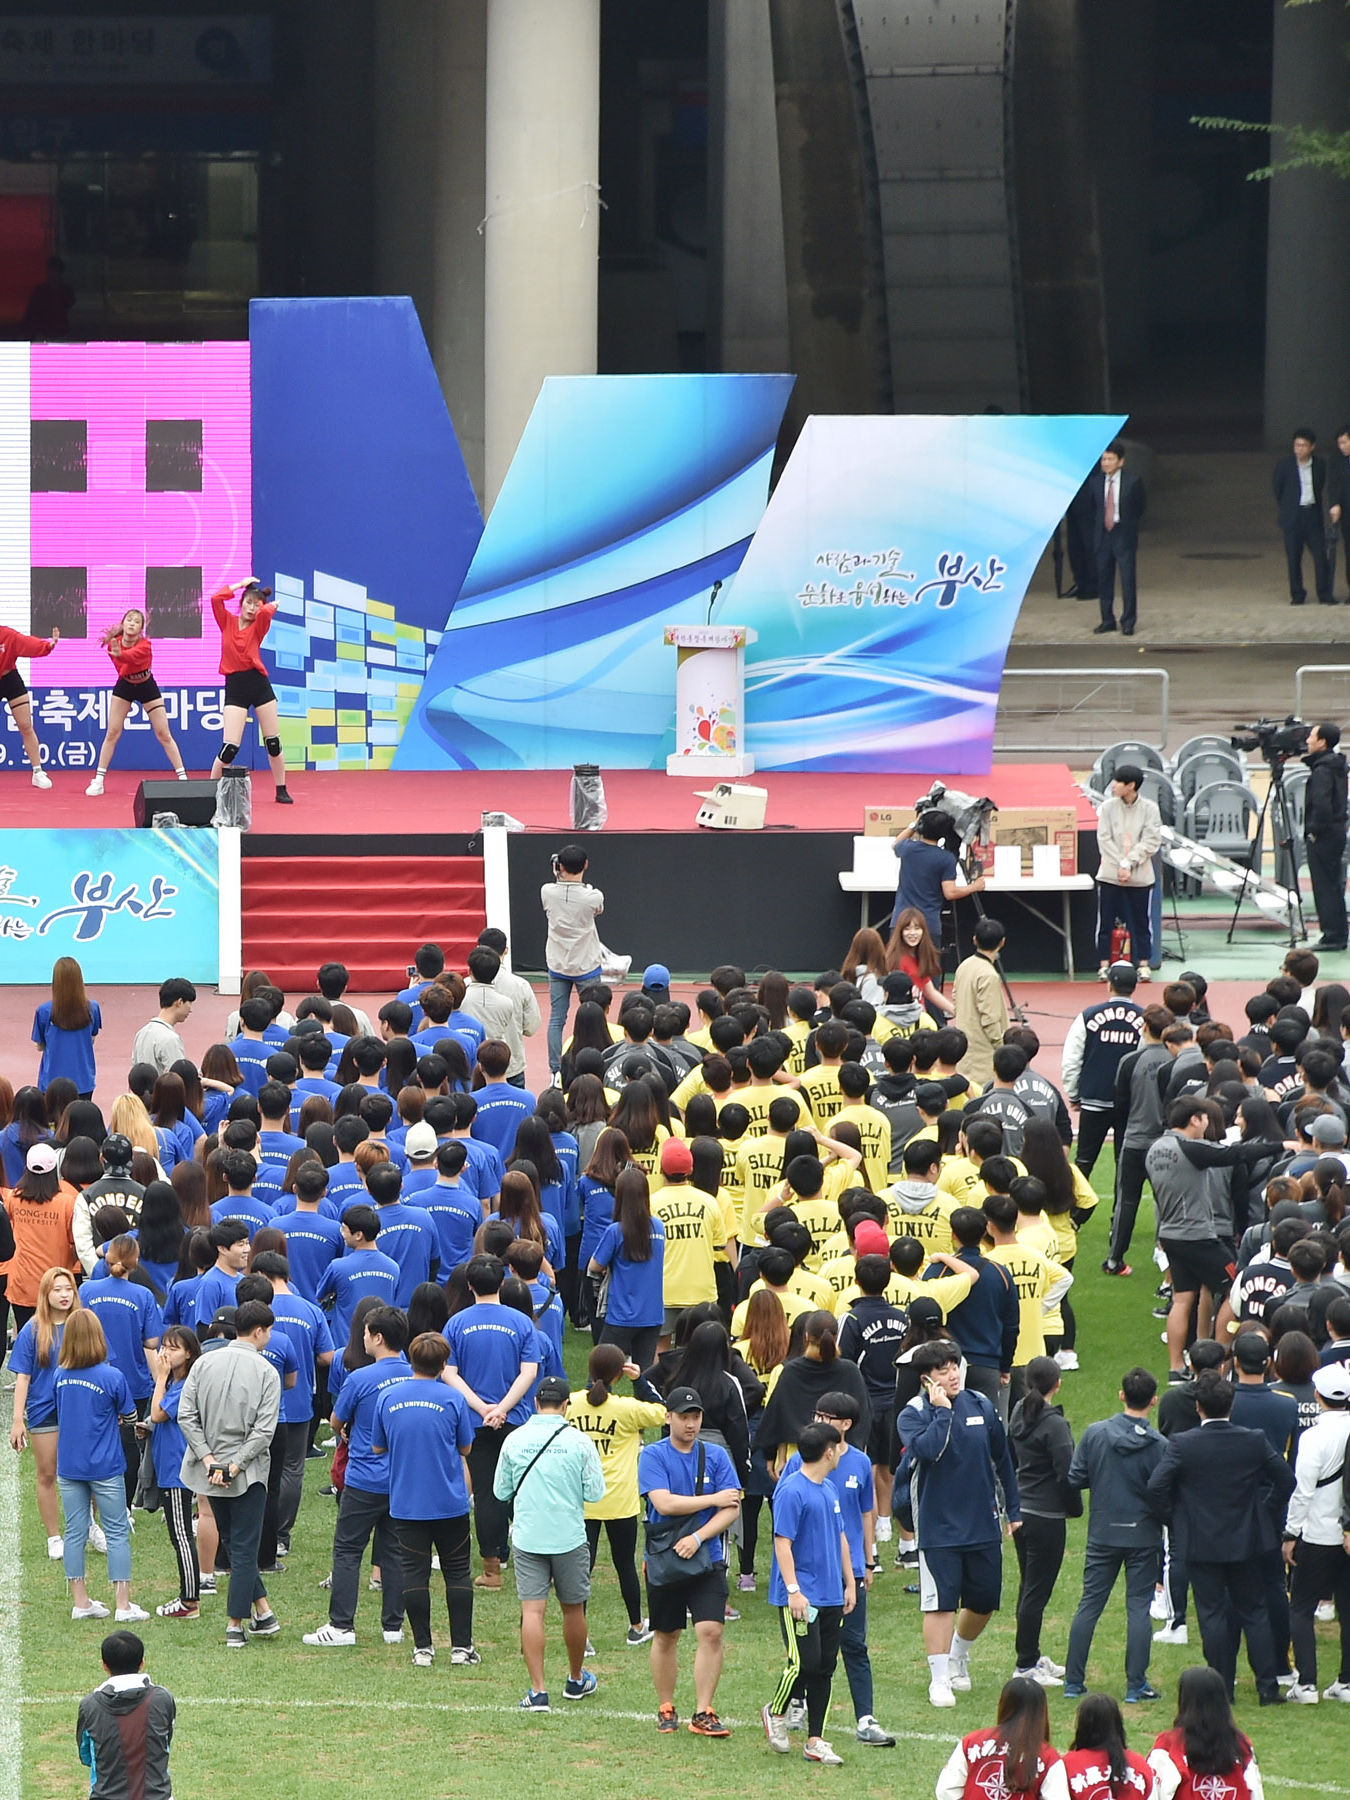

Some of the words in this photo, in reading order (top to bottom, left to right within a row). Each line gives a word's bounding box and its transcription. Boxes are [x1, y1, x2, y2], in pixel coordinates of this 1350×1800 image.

[71, 27, 156, 56] 한마당
[914, 553, 1006, 608] 부산
[39, 872, 178, 942] 부산
[1109, 1029, 1138, 1045] UNIV.
[490, 1100, 527, 1111] UNIVERSITY
[433, 1205, 470, 1218] UNIVERSITY
[658, 1201, 706, 1223] SILLA
[290, 1230, 328, 1244] UNIVERSITY
[388, 1224, 422, 1236] UNIVERSITY
[665, 1222, 704, 1241] UNIV.
[894, 1221, 938, 1239] UNIV.
[361, 1270, 396, 1282] UNIVERSITY
[102, 1296, 139, 1311] UNIVERSITY
[274, 1316, 312, 1331] UNIVERSITY
[461, 1328, 477, 1337] INJE
[477, 1324, 516, 1337] UNIVERSITY
[861, 1319, 883, 1341] SILLA
[68, 1378, 105, 1395] UNIVERSITY
[388, 1405, 403, 1414] INJE
[403, 1402, 444, 1414] UNIVERSITY
